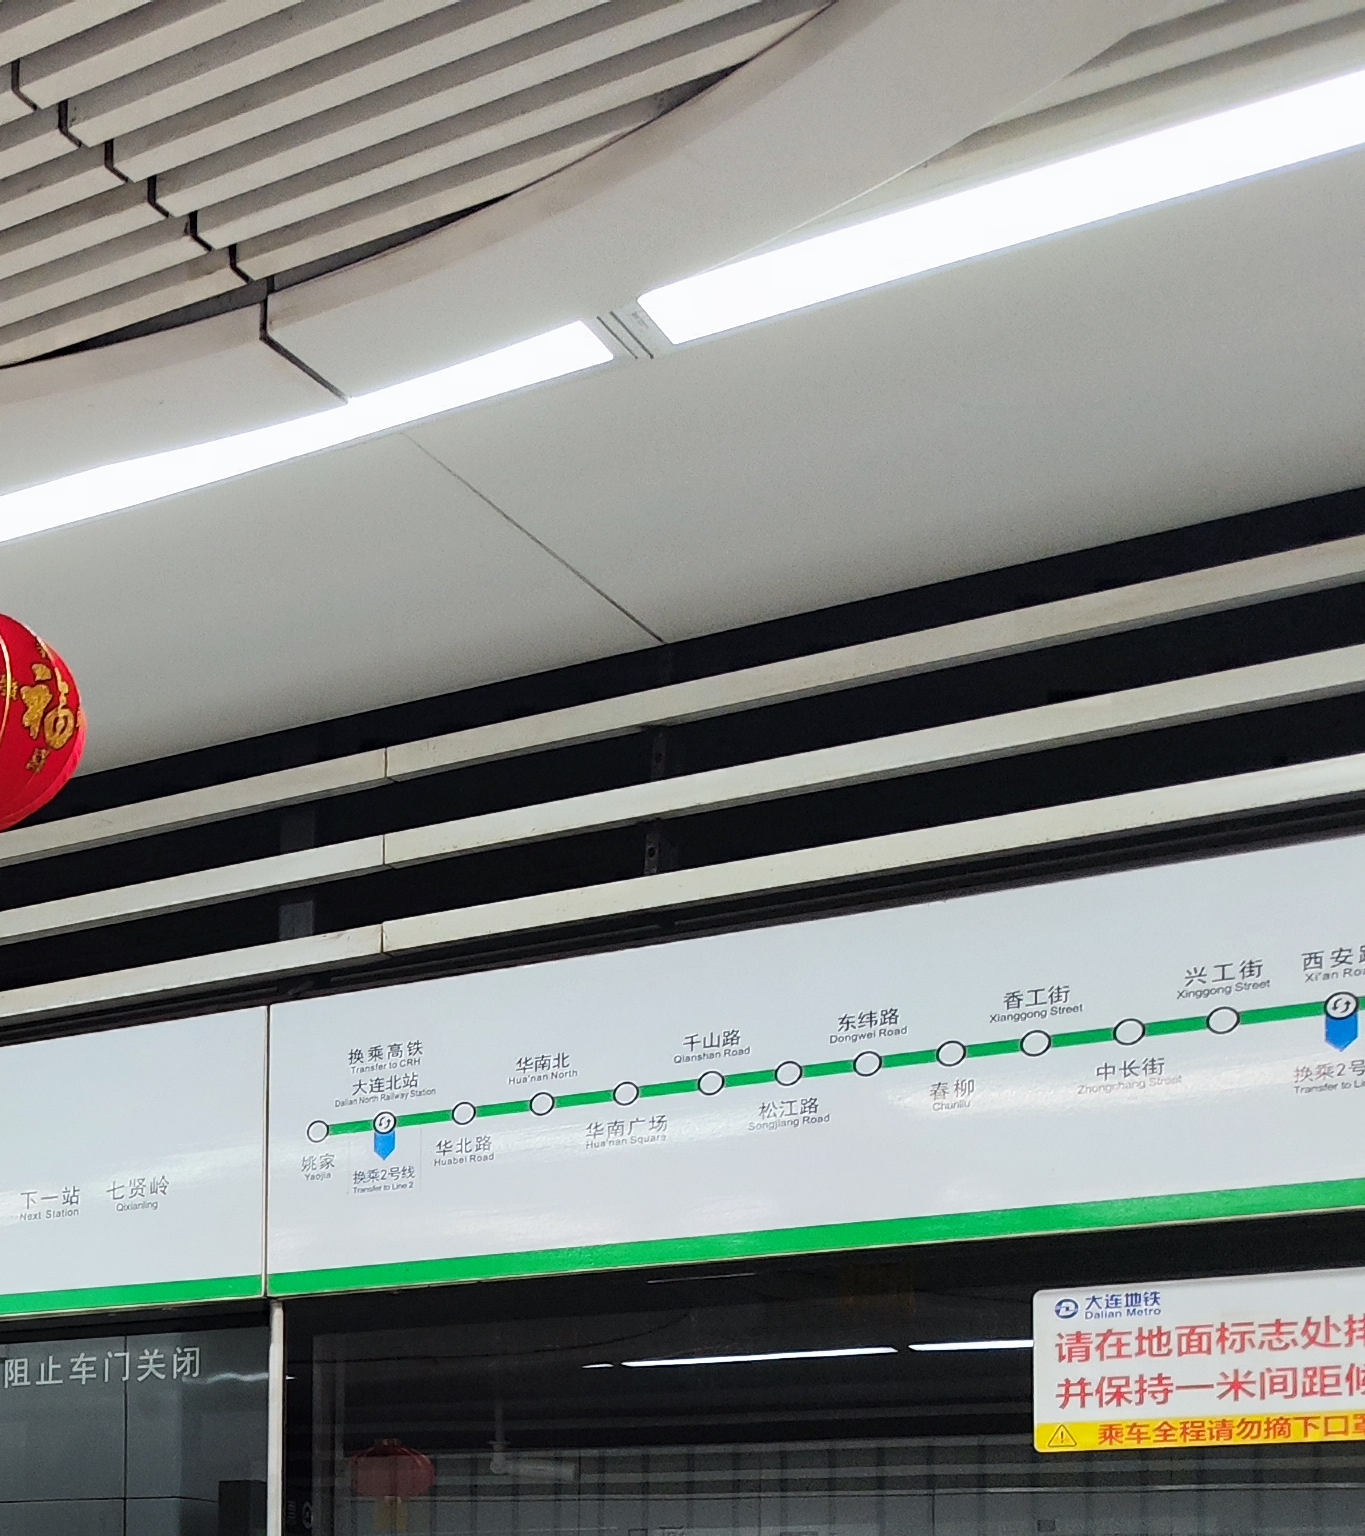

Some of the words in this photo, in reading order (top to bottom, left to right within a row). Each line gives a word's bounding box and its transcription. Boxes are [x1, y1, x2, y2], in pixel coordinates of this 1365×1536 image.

[1301, 945, 1365, 971] 西安
[1184, 959, 1264, 987] 兴工街
[1004, 986, 1070, 1010] 香工街
[1177, 985, 1232, 999] Xinggong
[1235, 980, 1270, 992] Street
[838, 1008, 899, 1031] 东纬路
[990, 1009, 1047, 1023] Xianggong
[1051, 1004, 1083, 1016] Street
[683, 1030, 741, 1052] 千山路
[830, 1030, 876, 1043] Dongwei
[879, 1026, 907, 1037] Road
[348, 1040, 423, 1065] 换乘高铁
[674, 1050, 721, 1063] Qianshan
[724, 1047, 751, 1057] Road
[351, 1063, 386, 1074] Transfer
[388, 1061, 397, 1069] to
[400, 1058, 421, 1068] CRH
[516, 1052, 570, 1074] 华南北
[1096, 1057, 1165, 1081] 中长街
[352, 1072, 419, 1096] 大连北站
[551, 1069, 578, 1080] North
[930, 1079, 975, 1100] 春柳
[759, 1098, 819, 1119] 松江路
[586, 1115, 667, 1139] 华南广场
[748, 1119, 800, 1131] Songjiang
[803, 1114, 831, 1125] Road
[436, 1136, 492, 1156] 华北路
[631, 1134, 666, 1145] Square
[302, 1153, 335, 1172] 姚家
[434, 1156, 467, 1166] Huabei
[471, 1153, 494, 1163] Road
[353, 1165, 415, 1184] 换乘2号线
[20, 1186, 80, 1209] 下一站
[107, 1175, 169, 1200] 七贤岭
[20, 1210, 41, 1221] Next
[46, 1207, 79, 1219] Station
[117, 1201, 158, 1211] Qixianling
[1085, 1291, 1161, 1310] 大连地铁
[1085, 1311, 1122, 1320] Dalian
[1126, 1307, 1161, 1317] Metro
